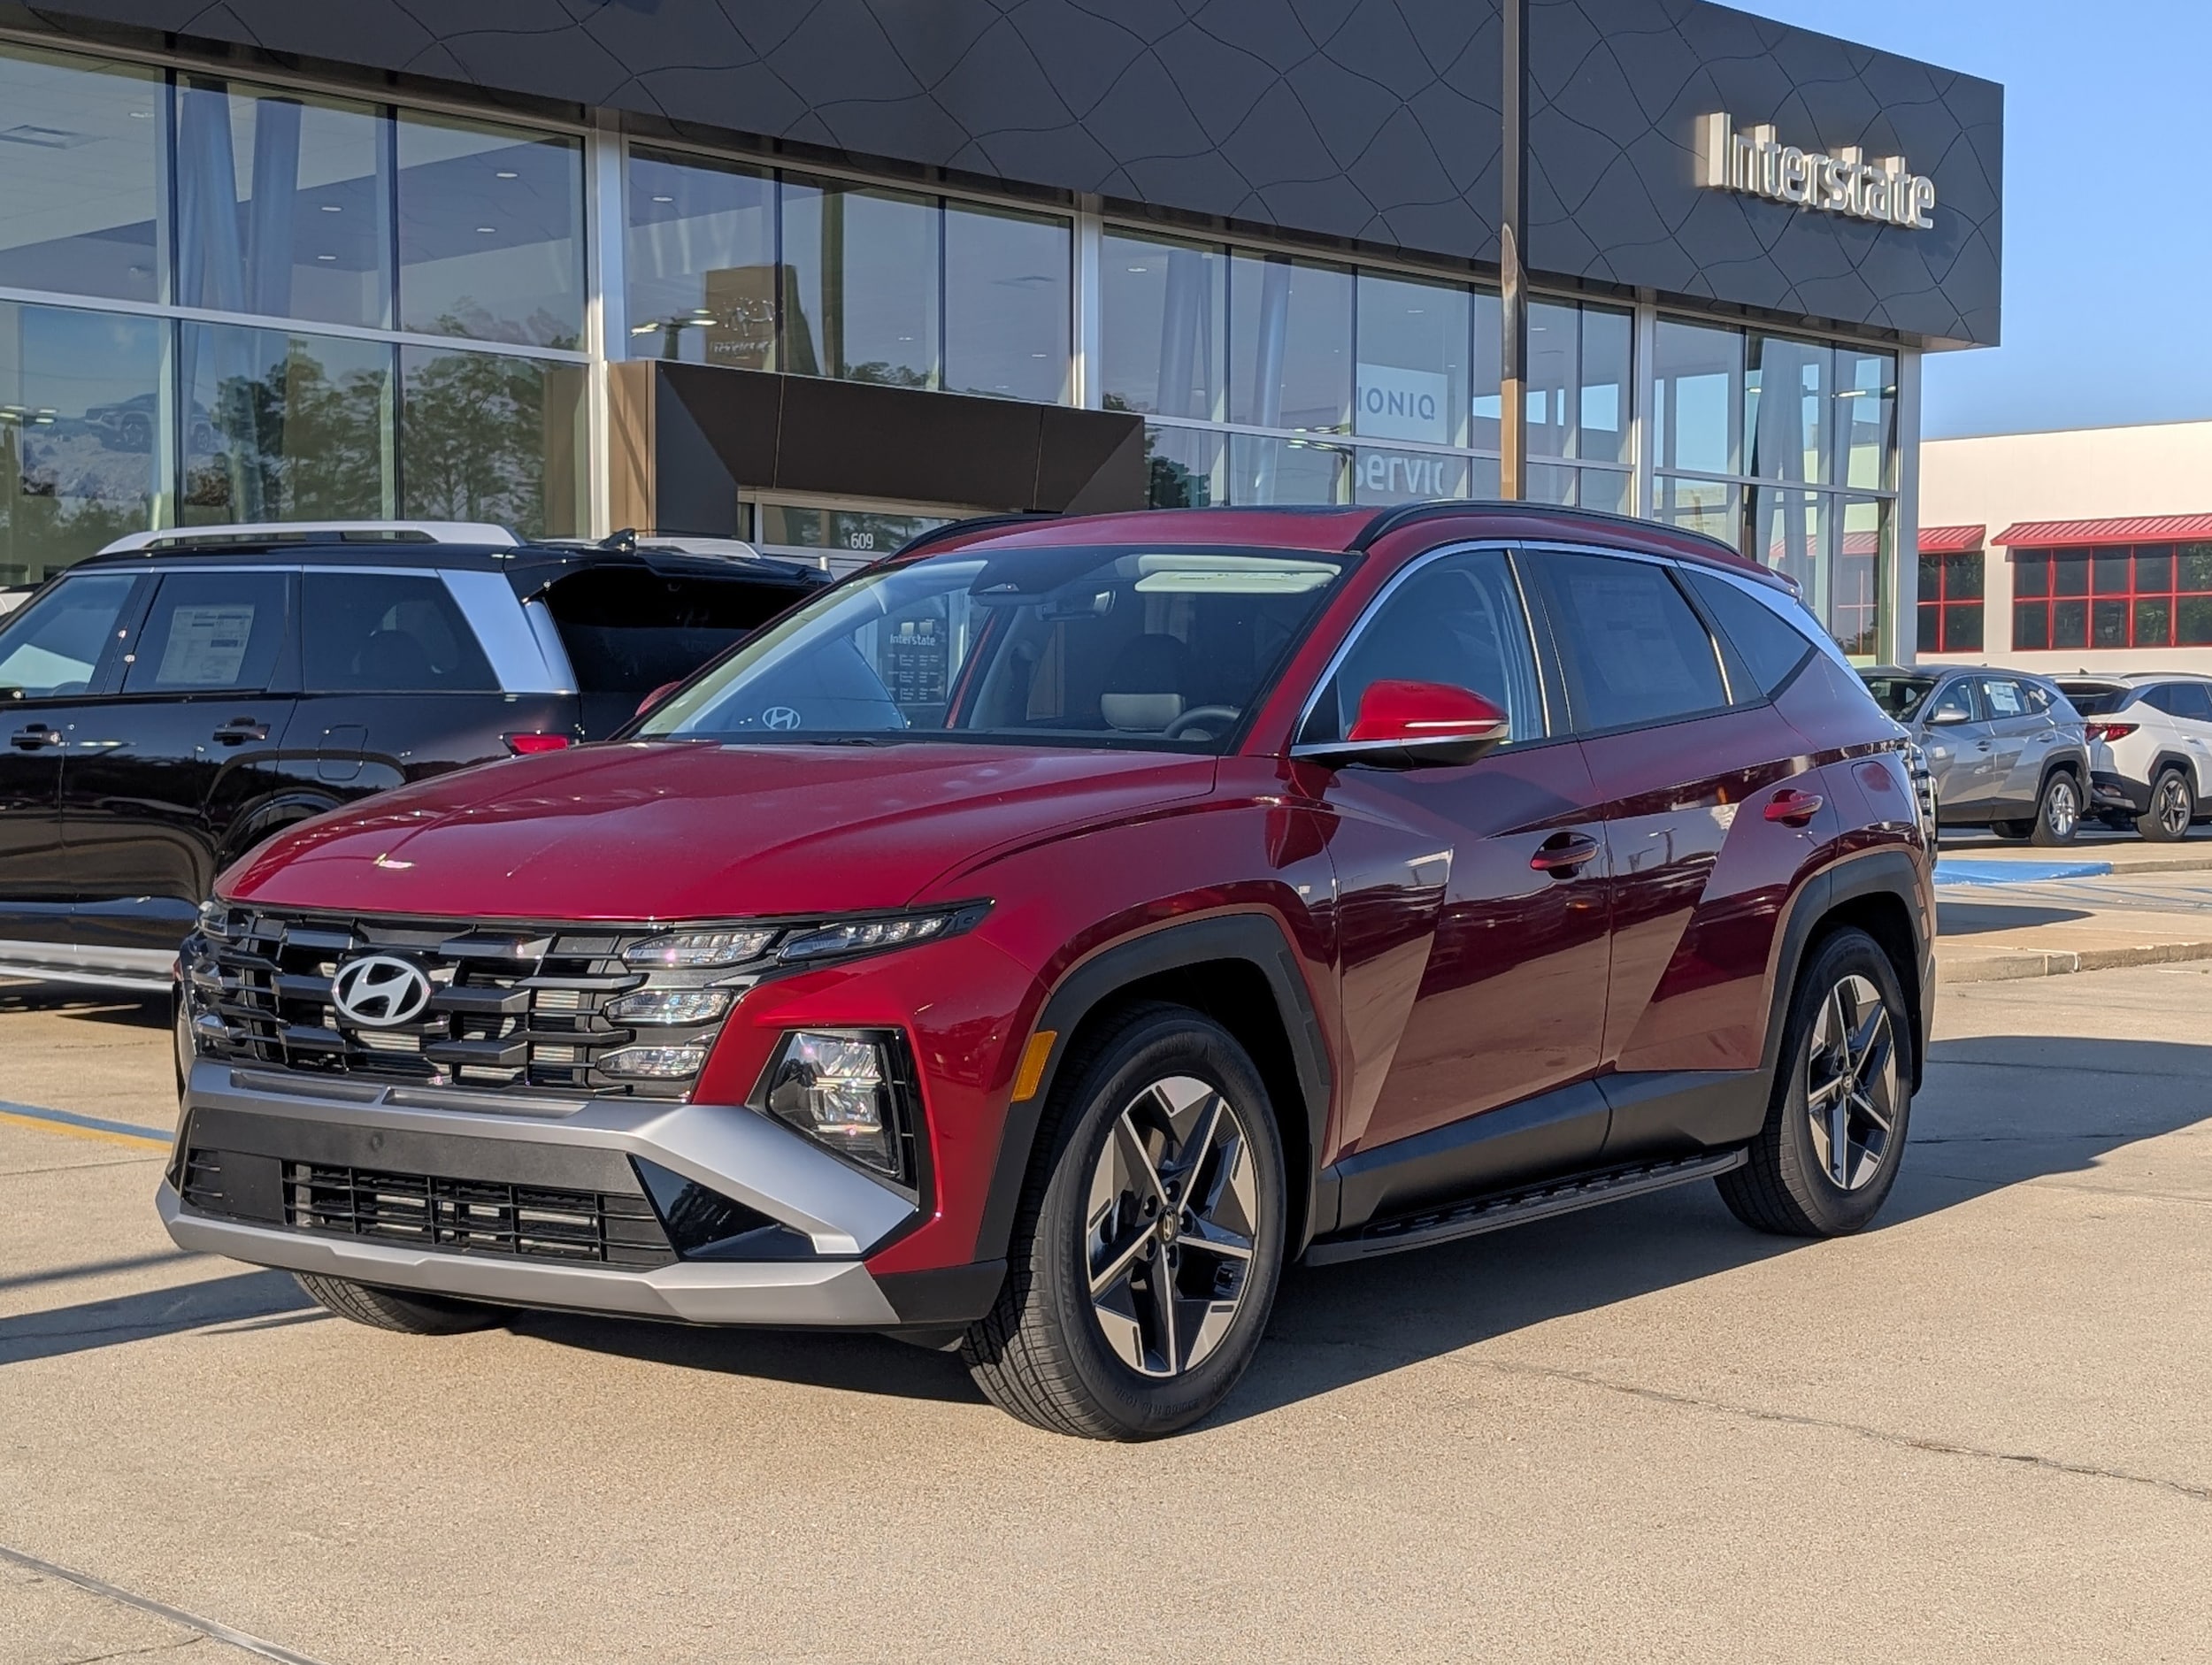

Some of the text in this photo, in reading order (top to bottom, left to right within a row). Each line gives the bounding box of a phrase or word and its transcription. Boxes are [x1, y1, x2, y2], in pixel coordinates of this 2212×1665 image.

[1696, 111, 1935, 229] Interstate
[1357, 386, 1435, 420] IONIQ
[850, 533, 874, 549] 609
[890, 633, 936, 646] Interstate
